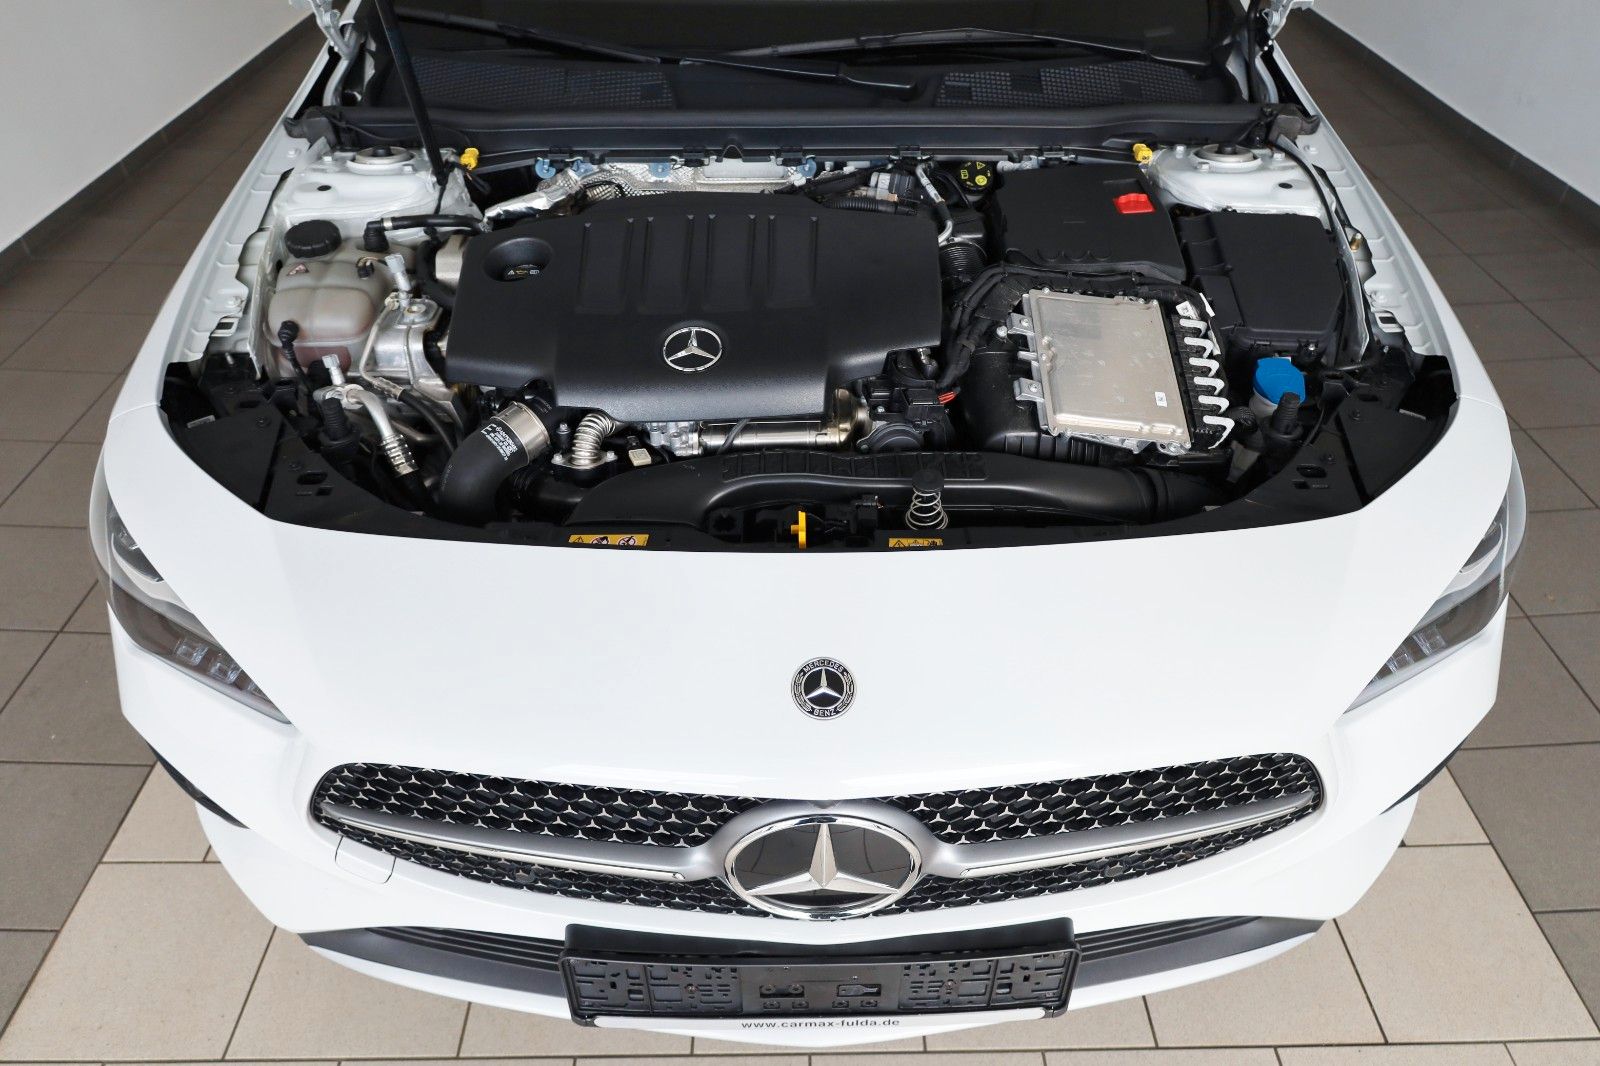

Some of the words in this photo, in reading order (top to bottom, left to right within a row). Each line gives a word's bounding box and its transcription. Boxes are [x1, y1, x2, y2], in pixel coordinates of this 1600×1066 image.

[802, 659, 845, 673] MERCEDES
[813, 708, 837, 717] BENZ
[741, 1018, 900, 1029] www.carmax-fulda.de
